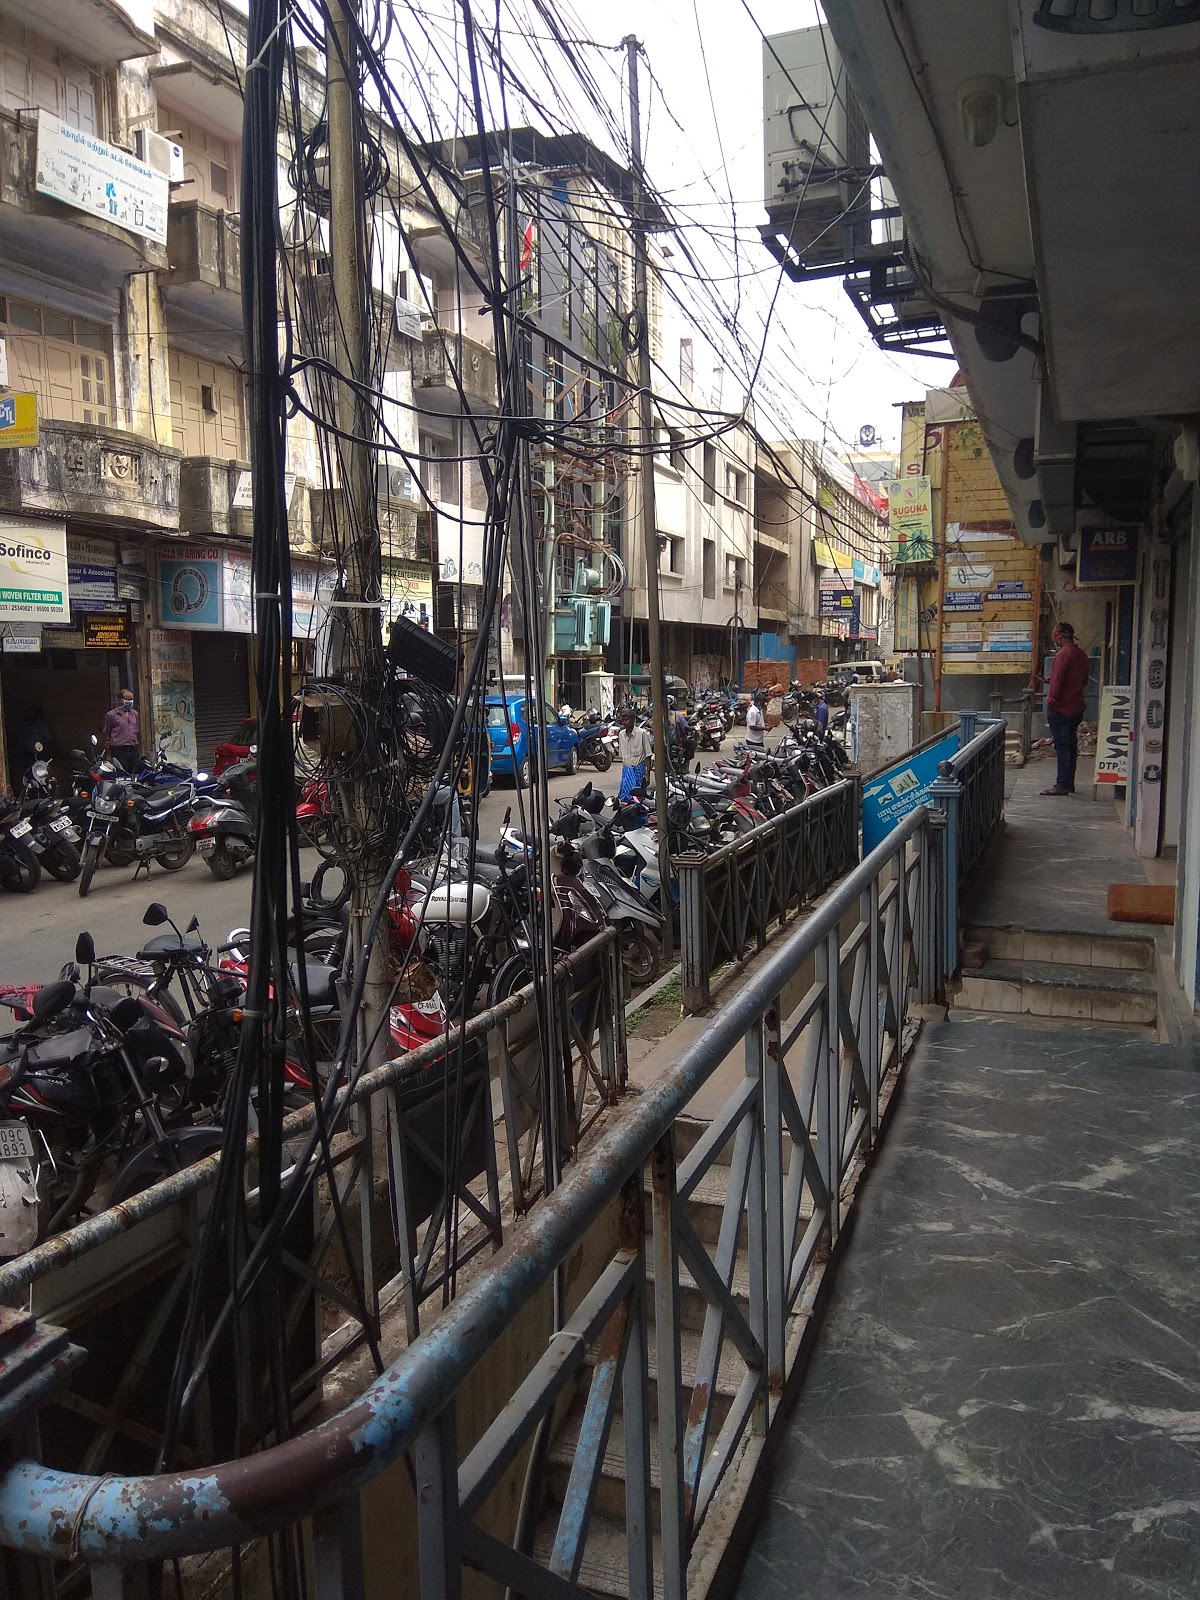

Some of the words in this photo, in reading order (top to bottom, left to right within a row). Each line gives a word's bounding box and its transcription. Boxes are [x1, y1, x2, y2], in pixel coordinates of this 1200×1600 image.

[111, 154, 124, 165] கடல்
[892, 503, 928, 516] SUGUNA
[1091, 531, 1128, 546] ARB
[0, 542, 51, 560] Sofinco
[2, 591, 22, 600] WOVEN
[23, 592, 41, 601] FILTER
[42, 593, 60, 602] MEDIA
[1099, 761, 1119, 770] DTP
